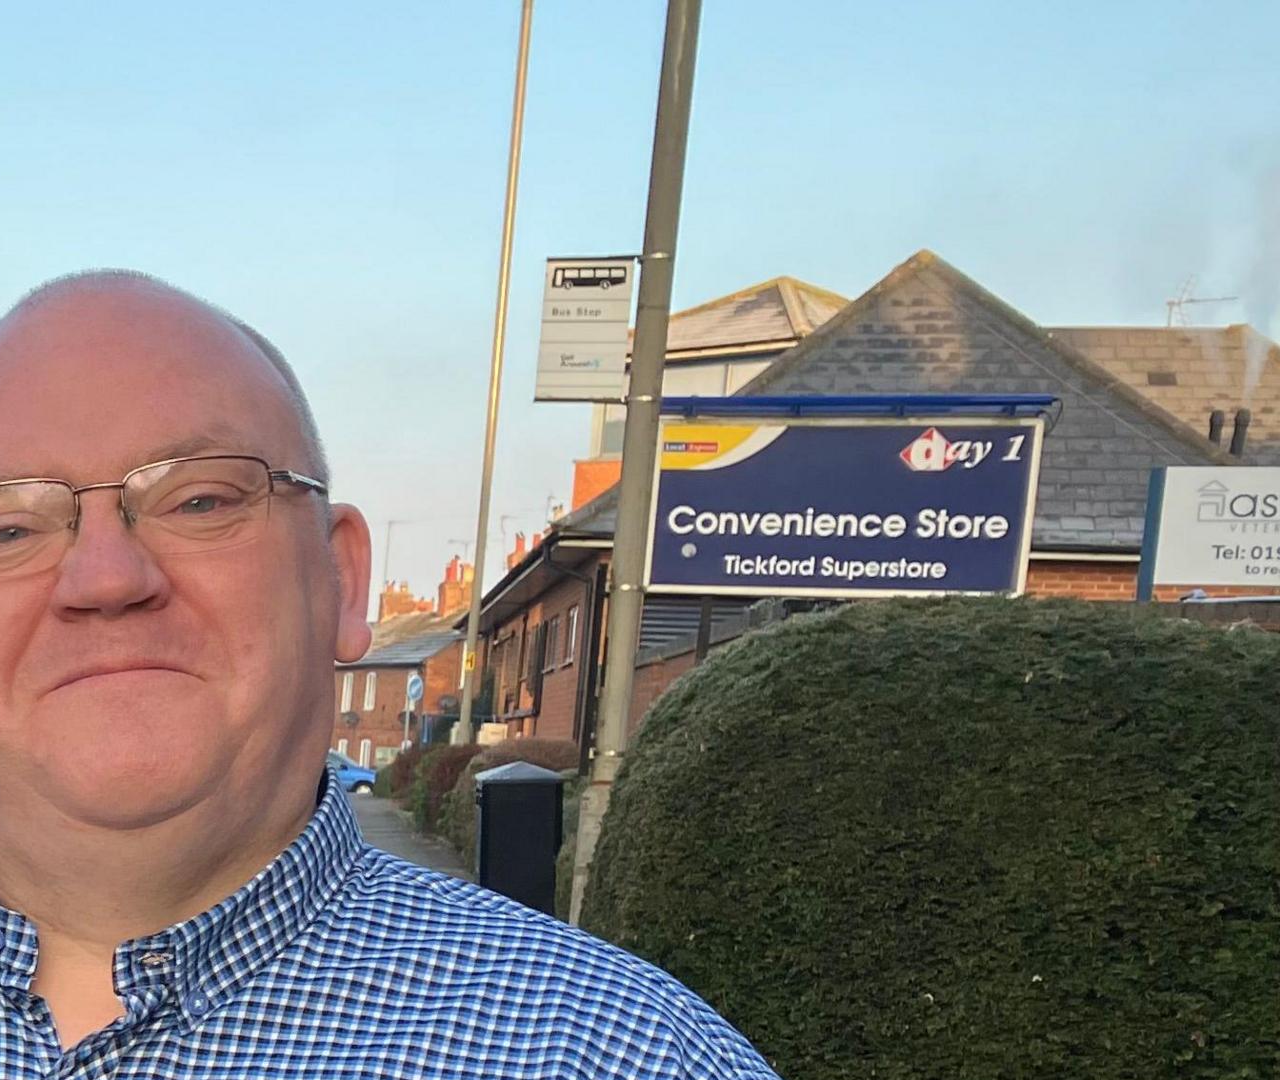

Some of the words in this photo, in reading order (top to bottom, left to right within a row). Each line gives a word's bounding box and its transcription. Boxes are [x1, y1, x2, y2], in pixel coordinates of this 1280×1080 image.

[551, 307, 571, 317] Bus
[576, 307, 602, 318] Stop
[909, 427, 992, 471] day
[1002, 434, 1025, 461] 1
[668, 505, 907, 538] Convenience
[916, 508, 1009, 539] Store
[1212, 545, 1245, 560] Tel:
[724, 554, 815, 576] Tickford
[821, 556, 946, 581] Superstore
[1246, 565, 1260, 575] to
